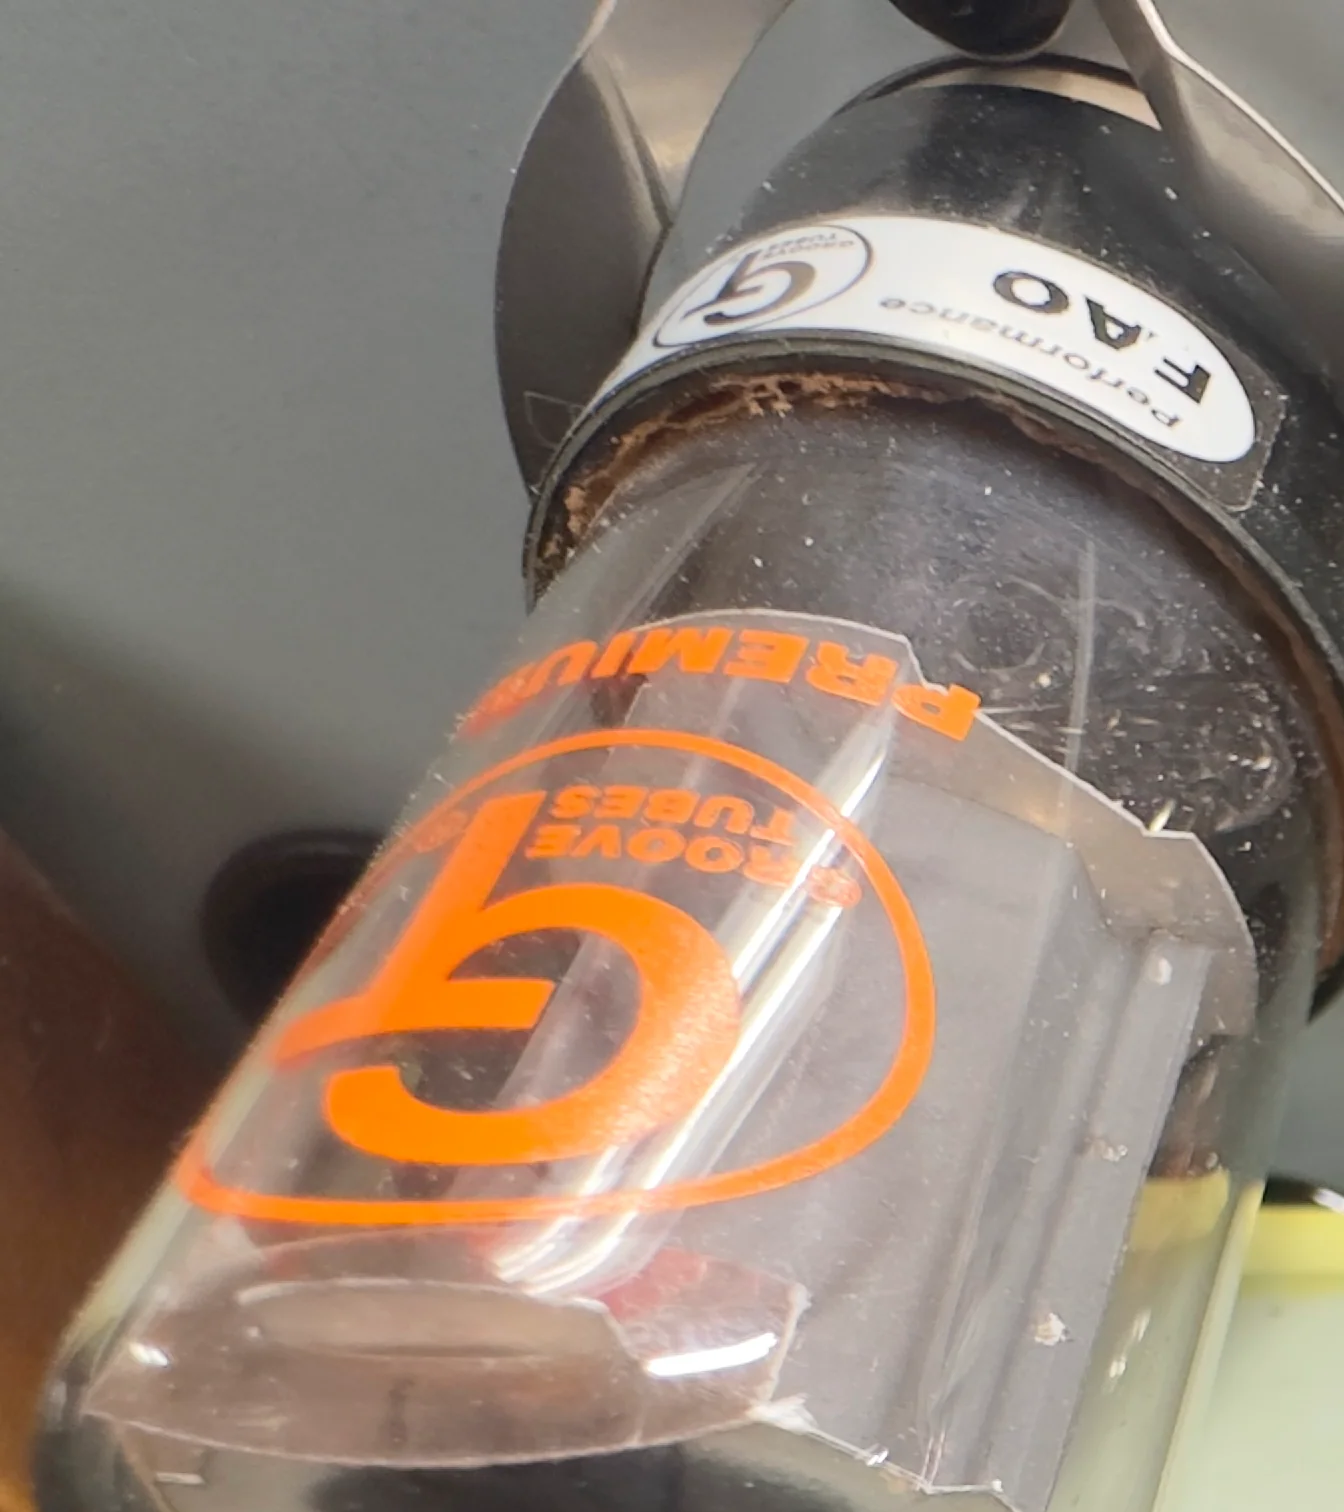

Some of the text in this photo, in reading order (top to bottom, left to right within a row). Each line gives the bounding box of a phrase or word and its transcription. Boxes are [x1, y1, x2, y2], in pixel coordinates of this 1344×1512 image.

[678, 248, 816, 328] GT
[877, 296, 1183, 432] Performance
[546, 781, 799, 845] TUBES
[523, 820, 863, 911] GROOVE
[268, 788, 742, 1167] GT
